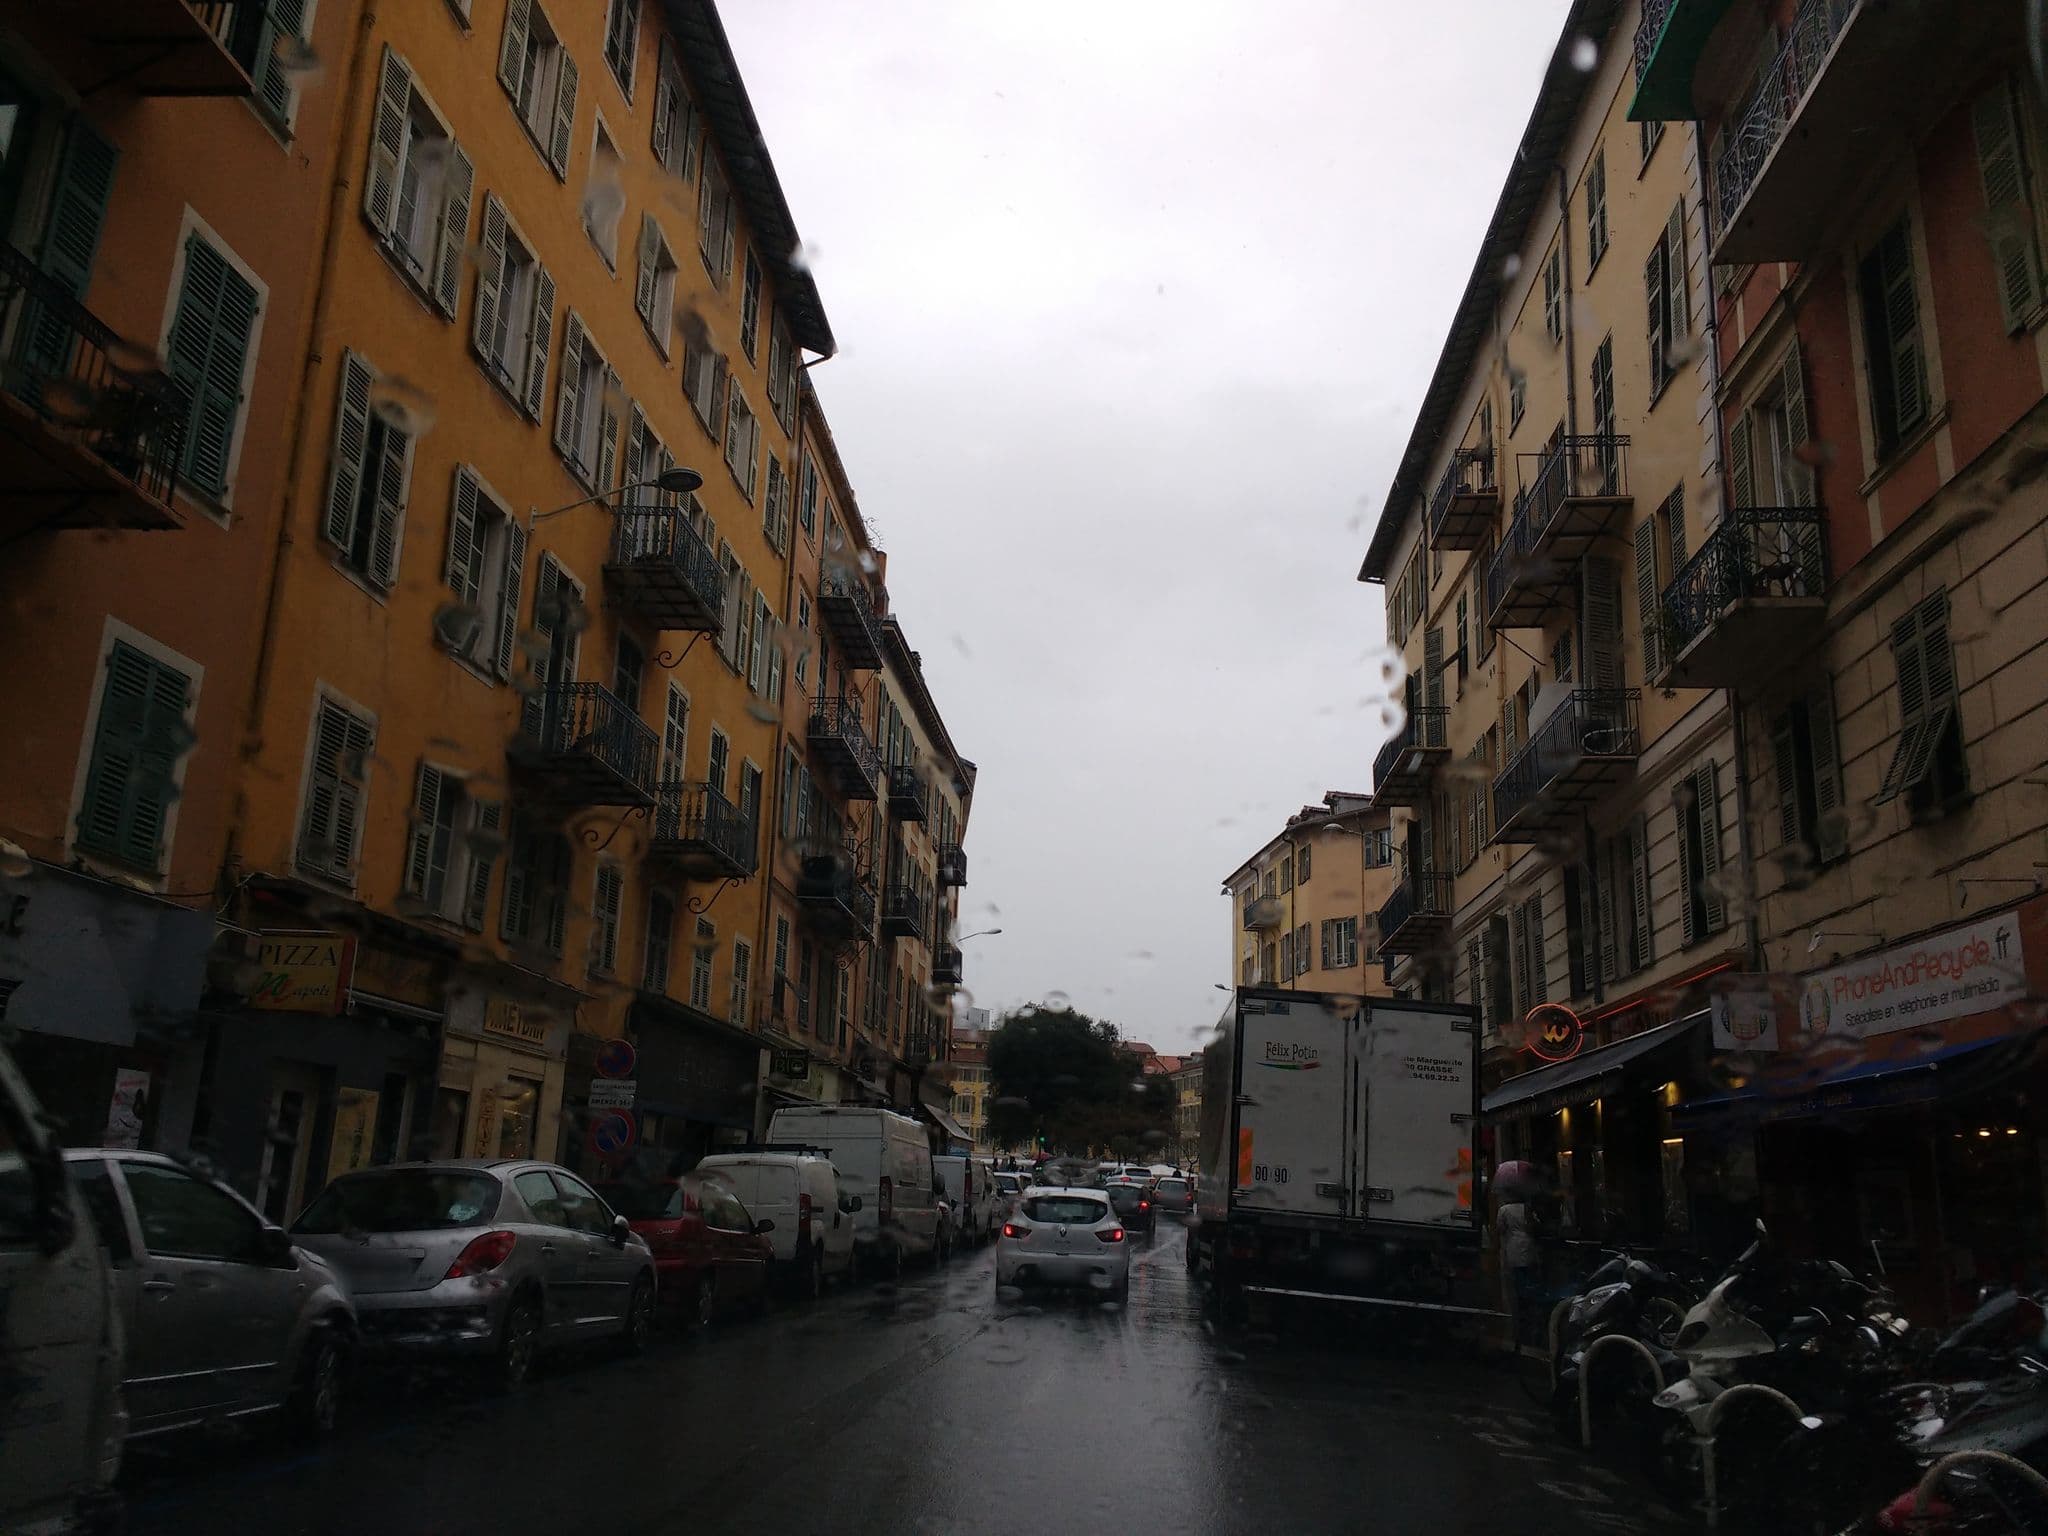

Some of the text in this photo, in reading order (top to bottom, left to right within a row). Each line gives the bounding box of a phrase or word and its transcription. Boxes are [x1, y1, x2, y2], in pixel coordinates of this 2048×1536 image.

[259, 943, 338, 966] PIZZA
[1886, 1005, 1896, 1018] en
[1265, 1041, 1318, 1060] Félix Potin
[1416, 1064, 1453, 1074] GRASSE
[1274, 1167, 1288, 1183] 90
